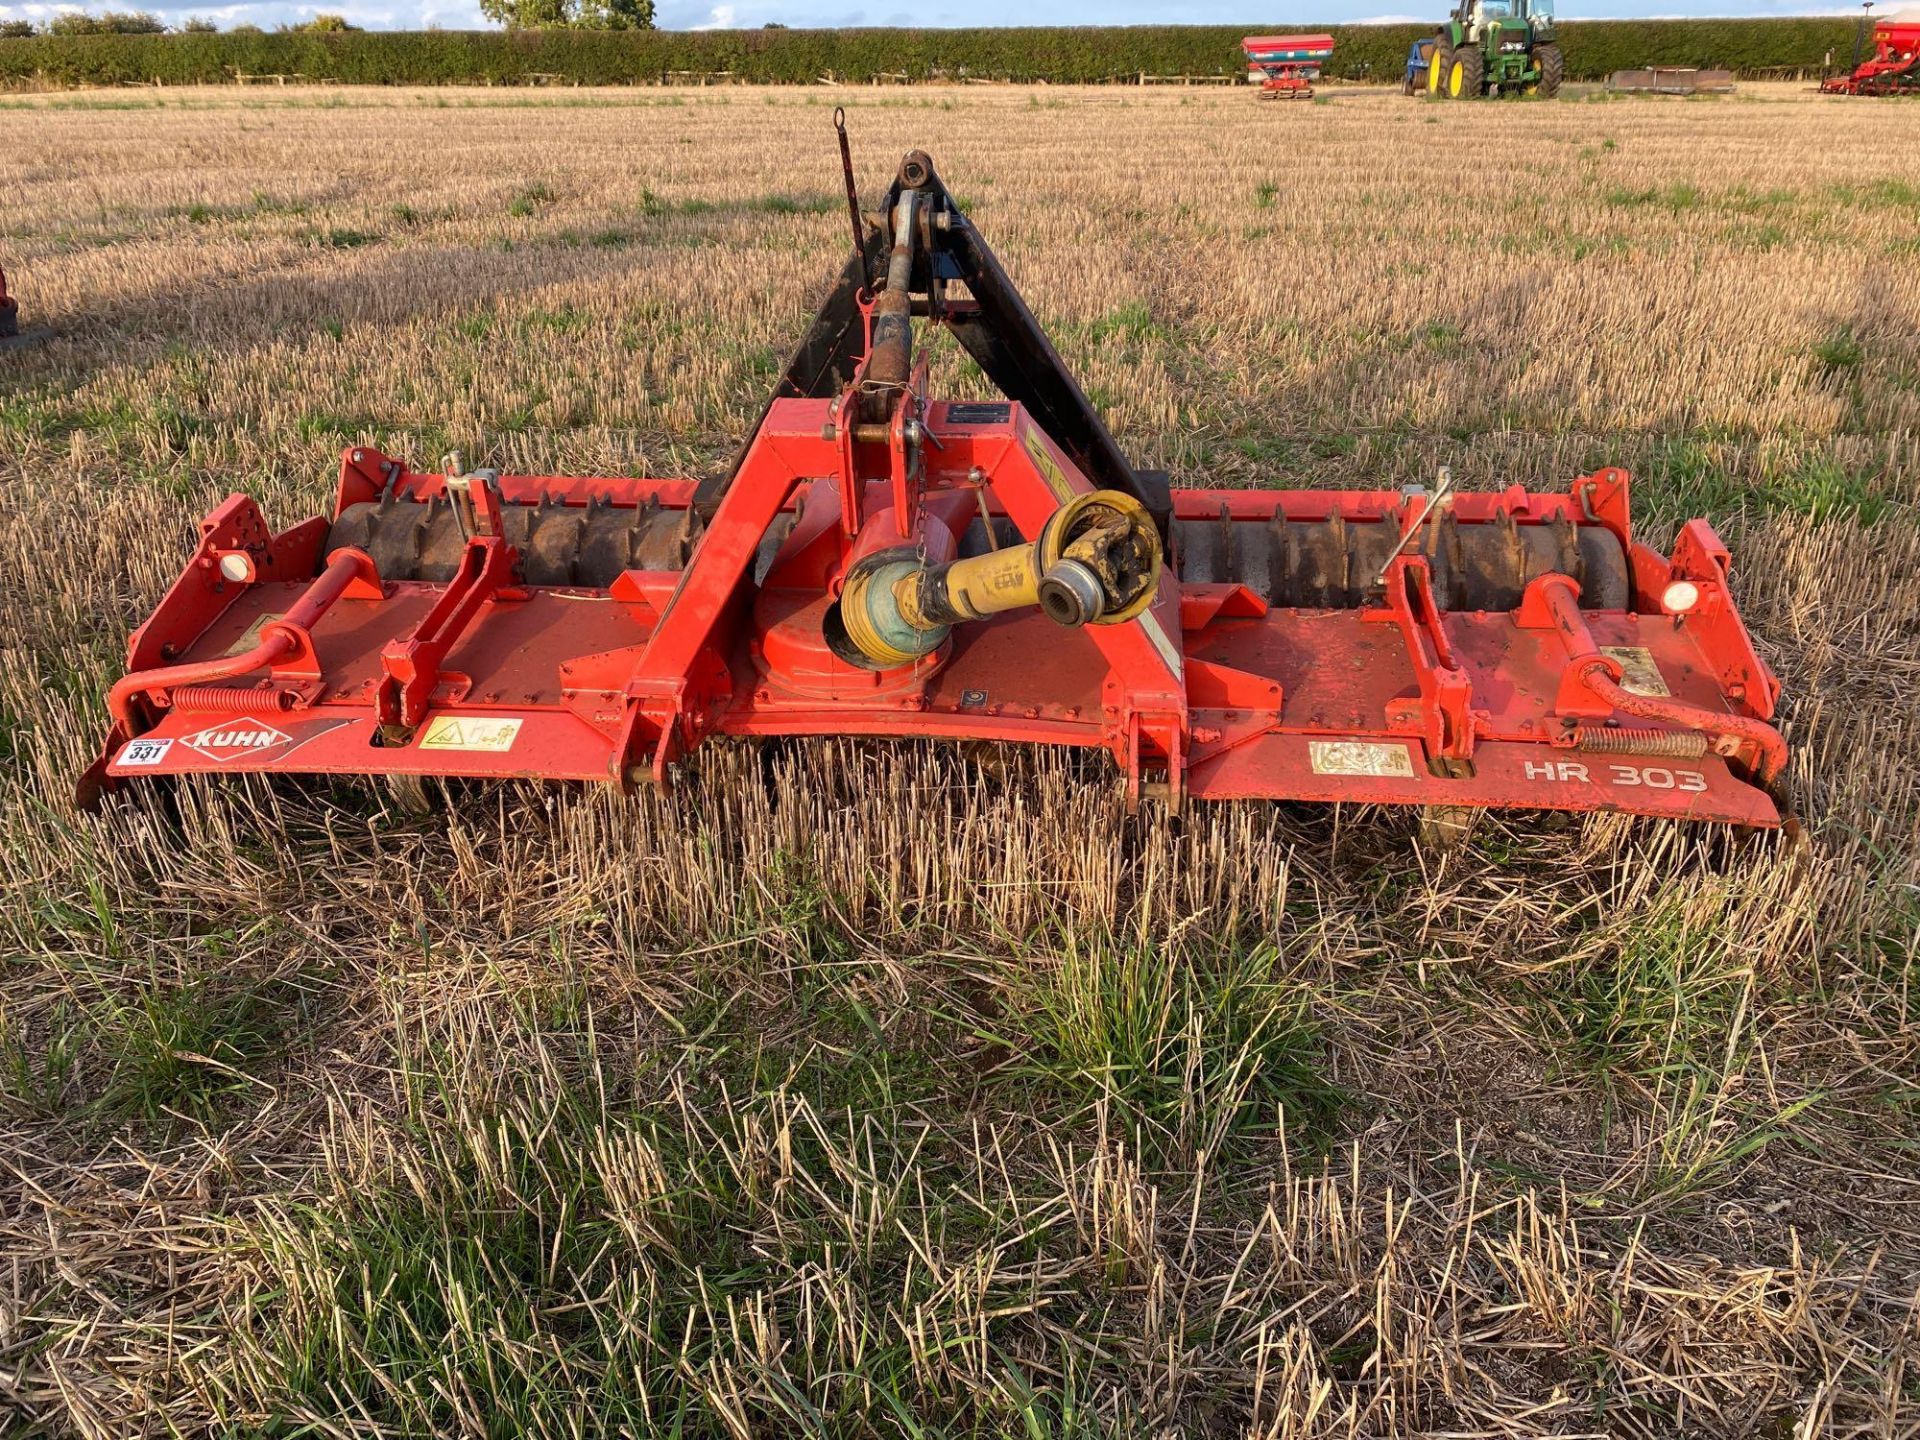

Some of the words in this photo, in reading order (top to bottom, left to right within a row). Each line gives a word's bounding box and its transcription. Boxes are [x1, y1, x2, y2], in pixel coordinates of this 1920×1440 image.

[192, 730, 278, 747] KUHN
[129, 745, 162, 759] 331
[1524, 760, 1591, 783] HR
[1609, 764, 1708, 791] 303
